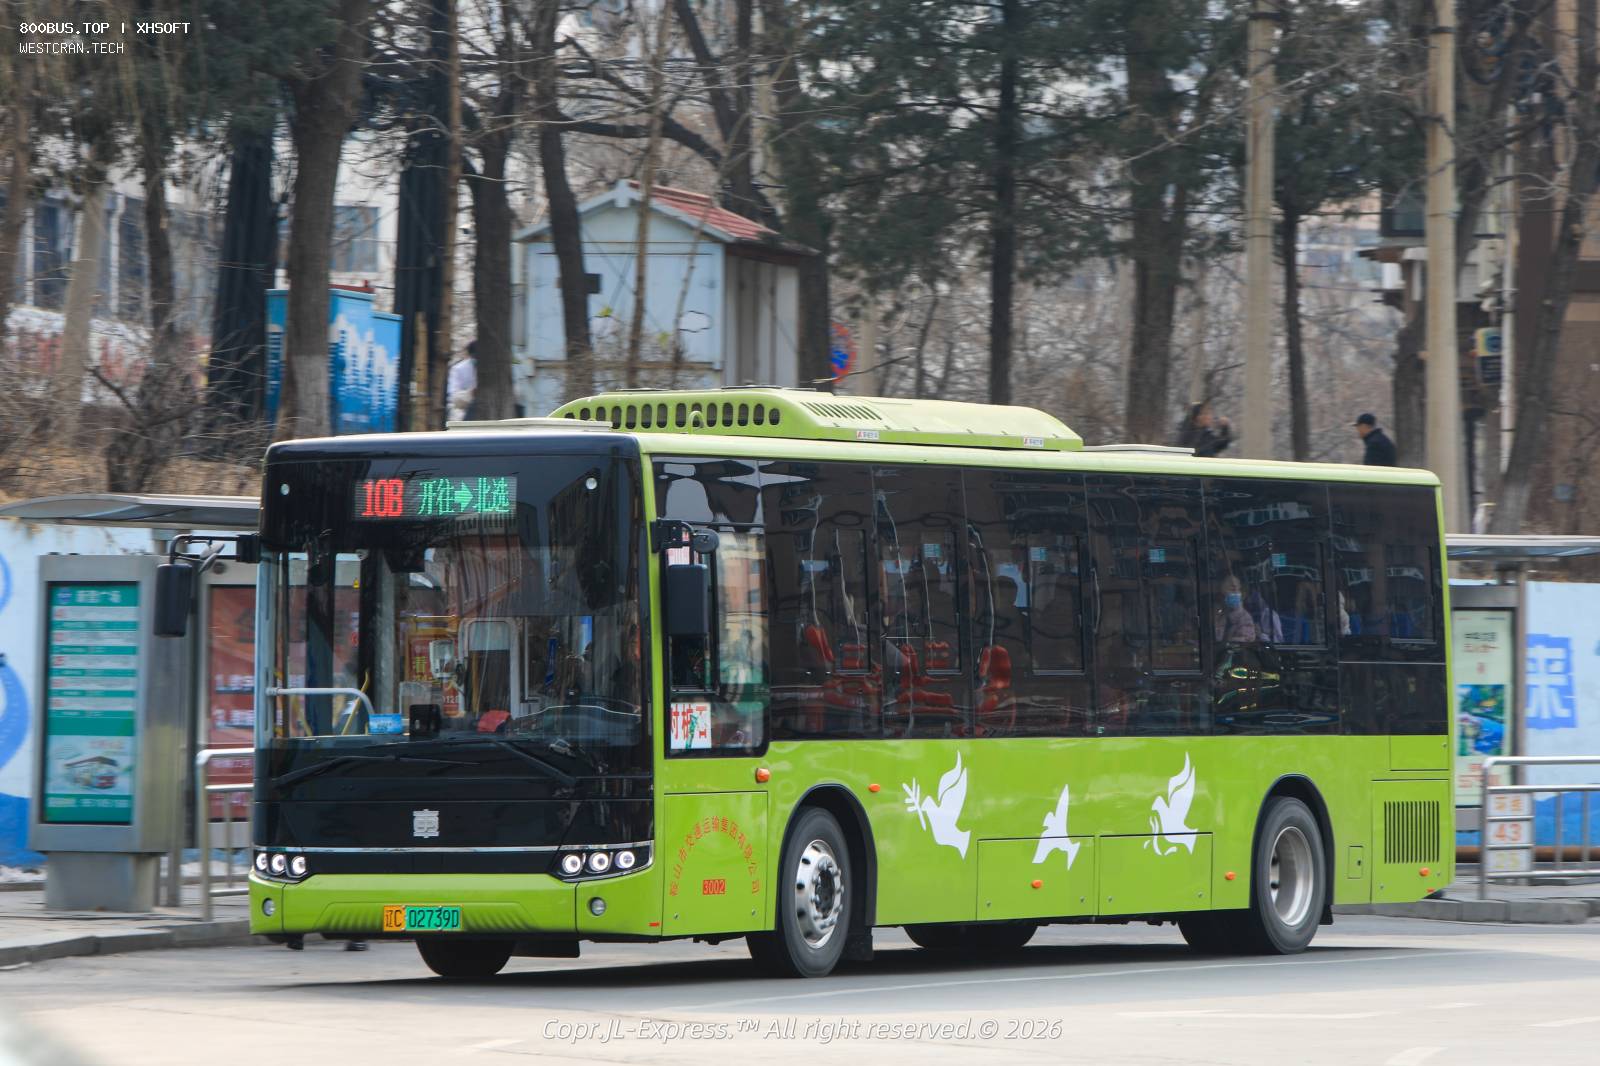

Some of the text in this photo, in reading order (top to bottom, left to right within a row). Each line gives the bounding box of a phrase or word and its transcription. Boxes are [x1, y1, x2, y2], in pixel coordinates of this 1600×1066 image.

[361, 479, 404, 517] 10B
[417, 477, 510, 515] 开往 北选
[1494, 823, 1521, 841] 43
[703, 880, 725, 894] 3002
[408, 909, 459, 928] 02739D
